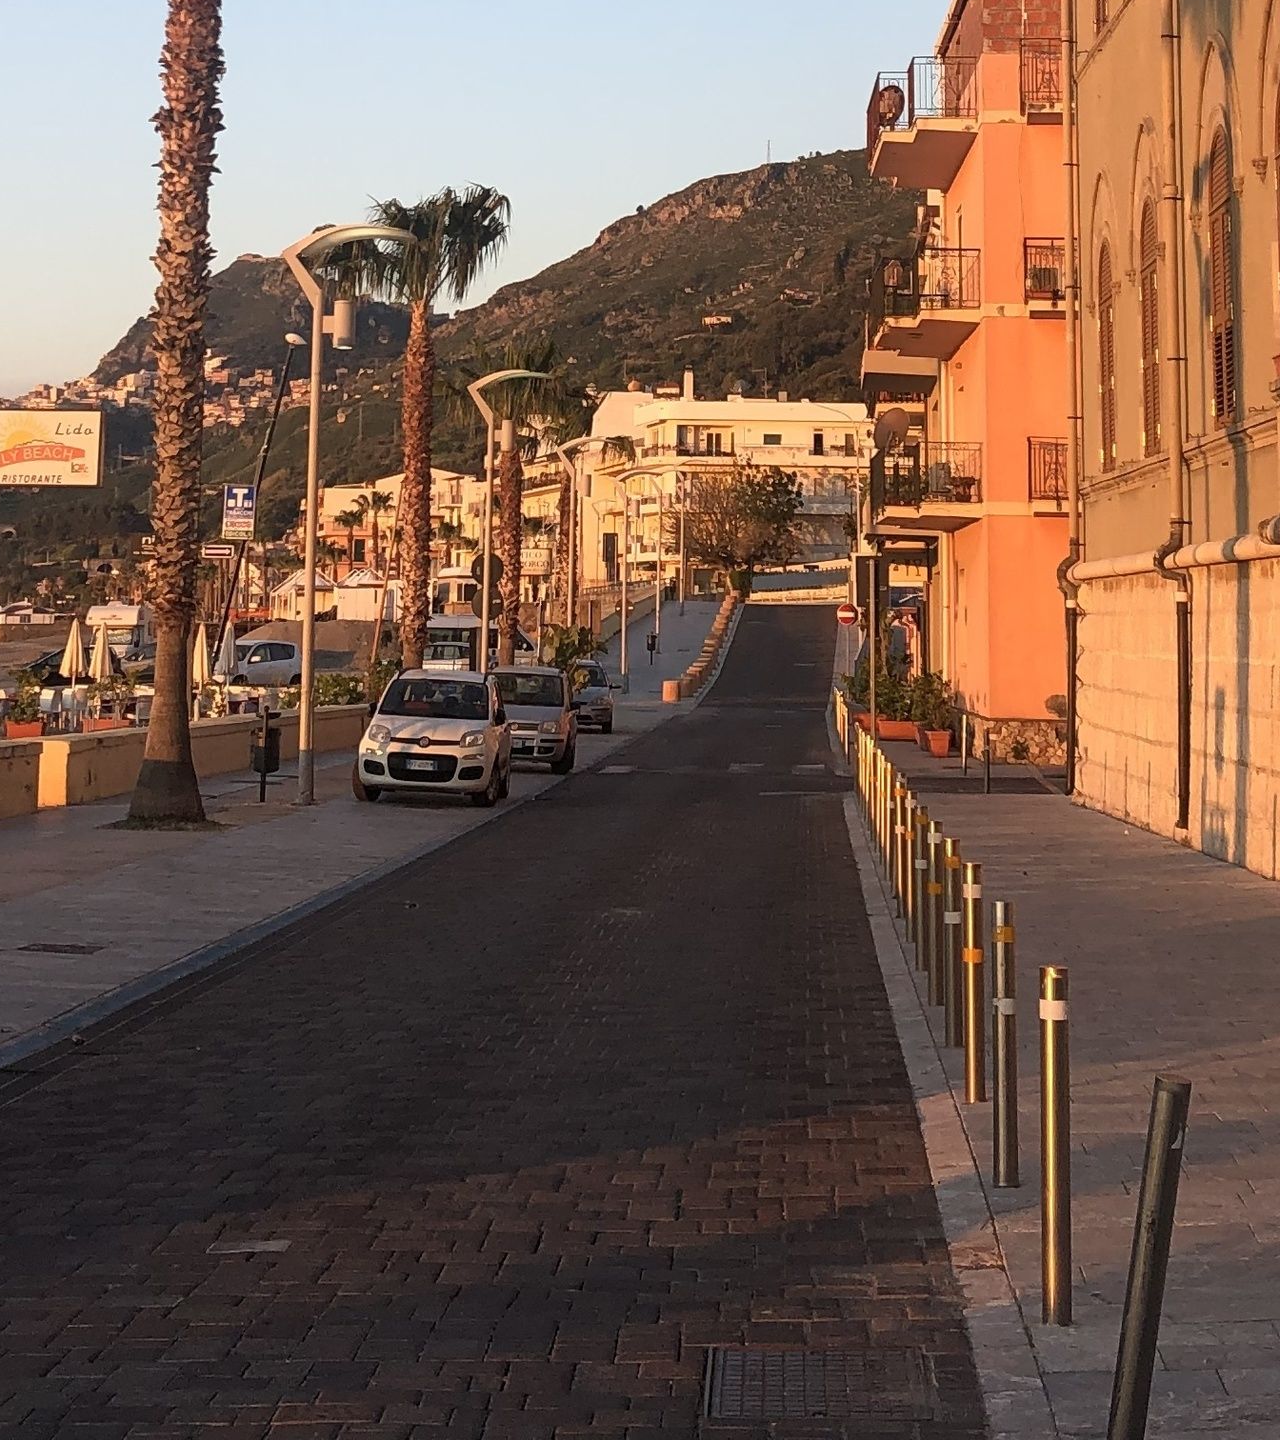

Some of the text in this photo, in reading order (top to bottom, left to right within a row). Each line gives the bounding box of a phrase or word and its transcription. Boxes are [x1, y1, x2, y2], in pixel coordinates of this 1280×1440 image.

[55, 422, 94, 436] Lido
[23, 446, 74, 461] BEACH
[1, 474, 63, 484] RISTORANTE
